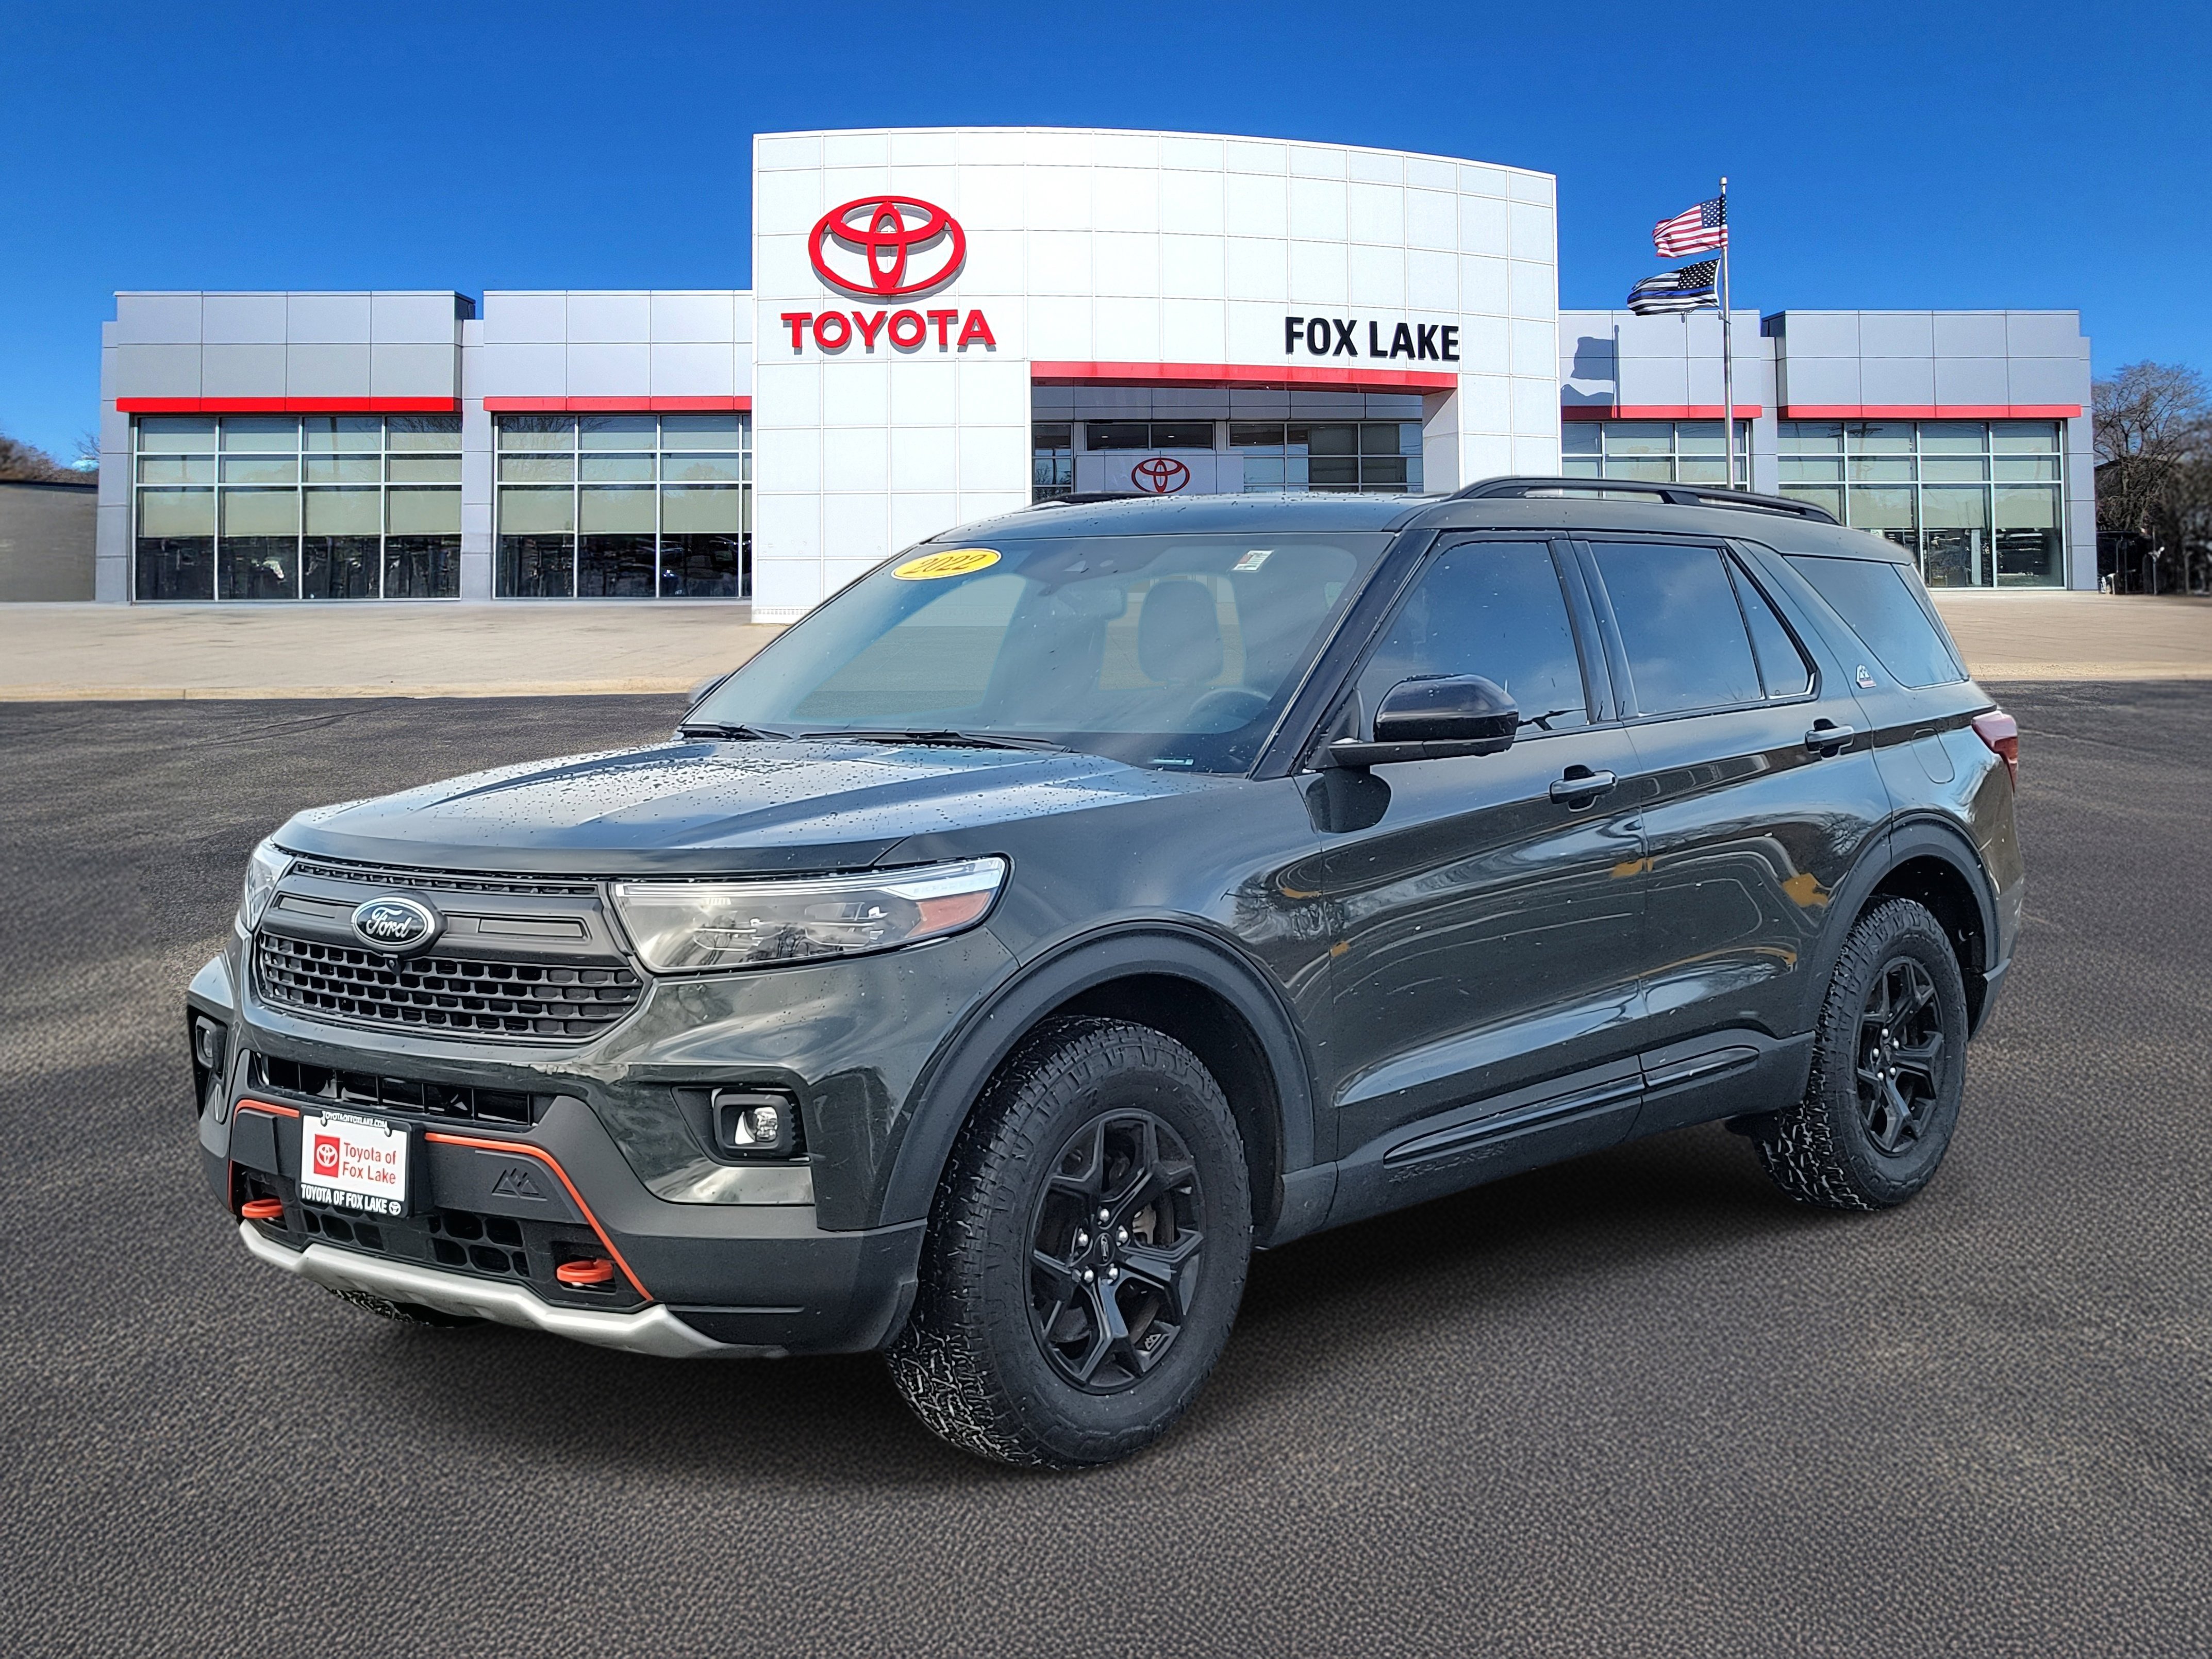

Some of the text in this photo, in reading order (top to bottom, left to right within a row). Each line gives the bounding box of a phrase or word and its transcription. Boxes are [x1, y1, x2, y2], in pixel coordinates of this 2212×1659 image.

[780, 309, 996, 353] TOYOTA
[1285, 316, 1460, 361] FOX LAKE
[903, 554, 987, 575] 2022
[366, 906, 412, 938] Ford
[343, 1141, 396, 1165] Toyota of
[342, 1161, 396, 1184] Fox Lake
[301, 1184, 388, 1214] TOYOTA OF FOX LAKE
